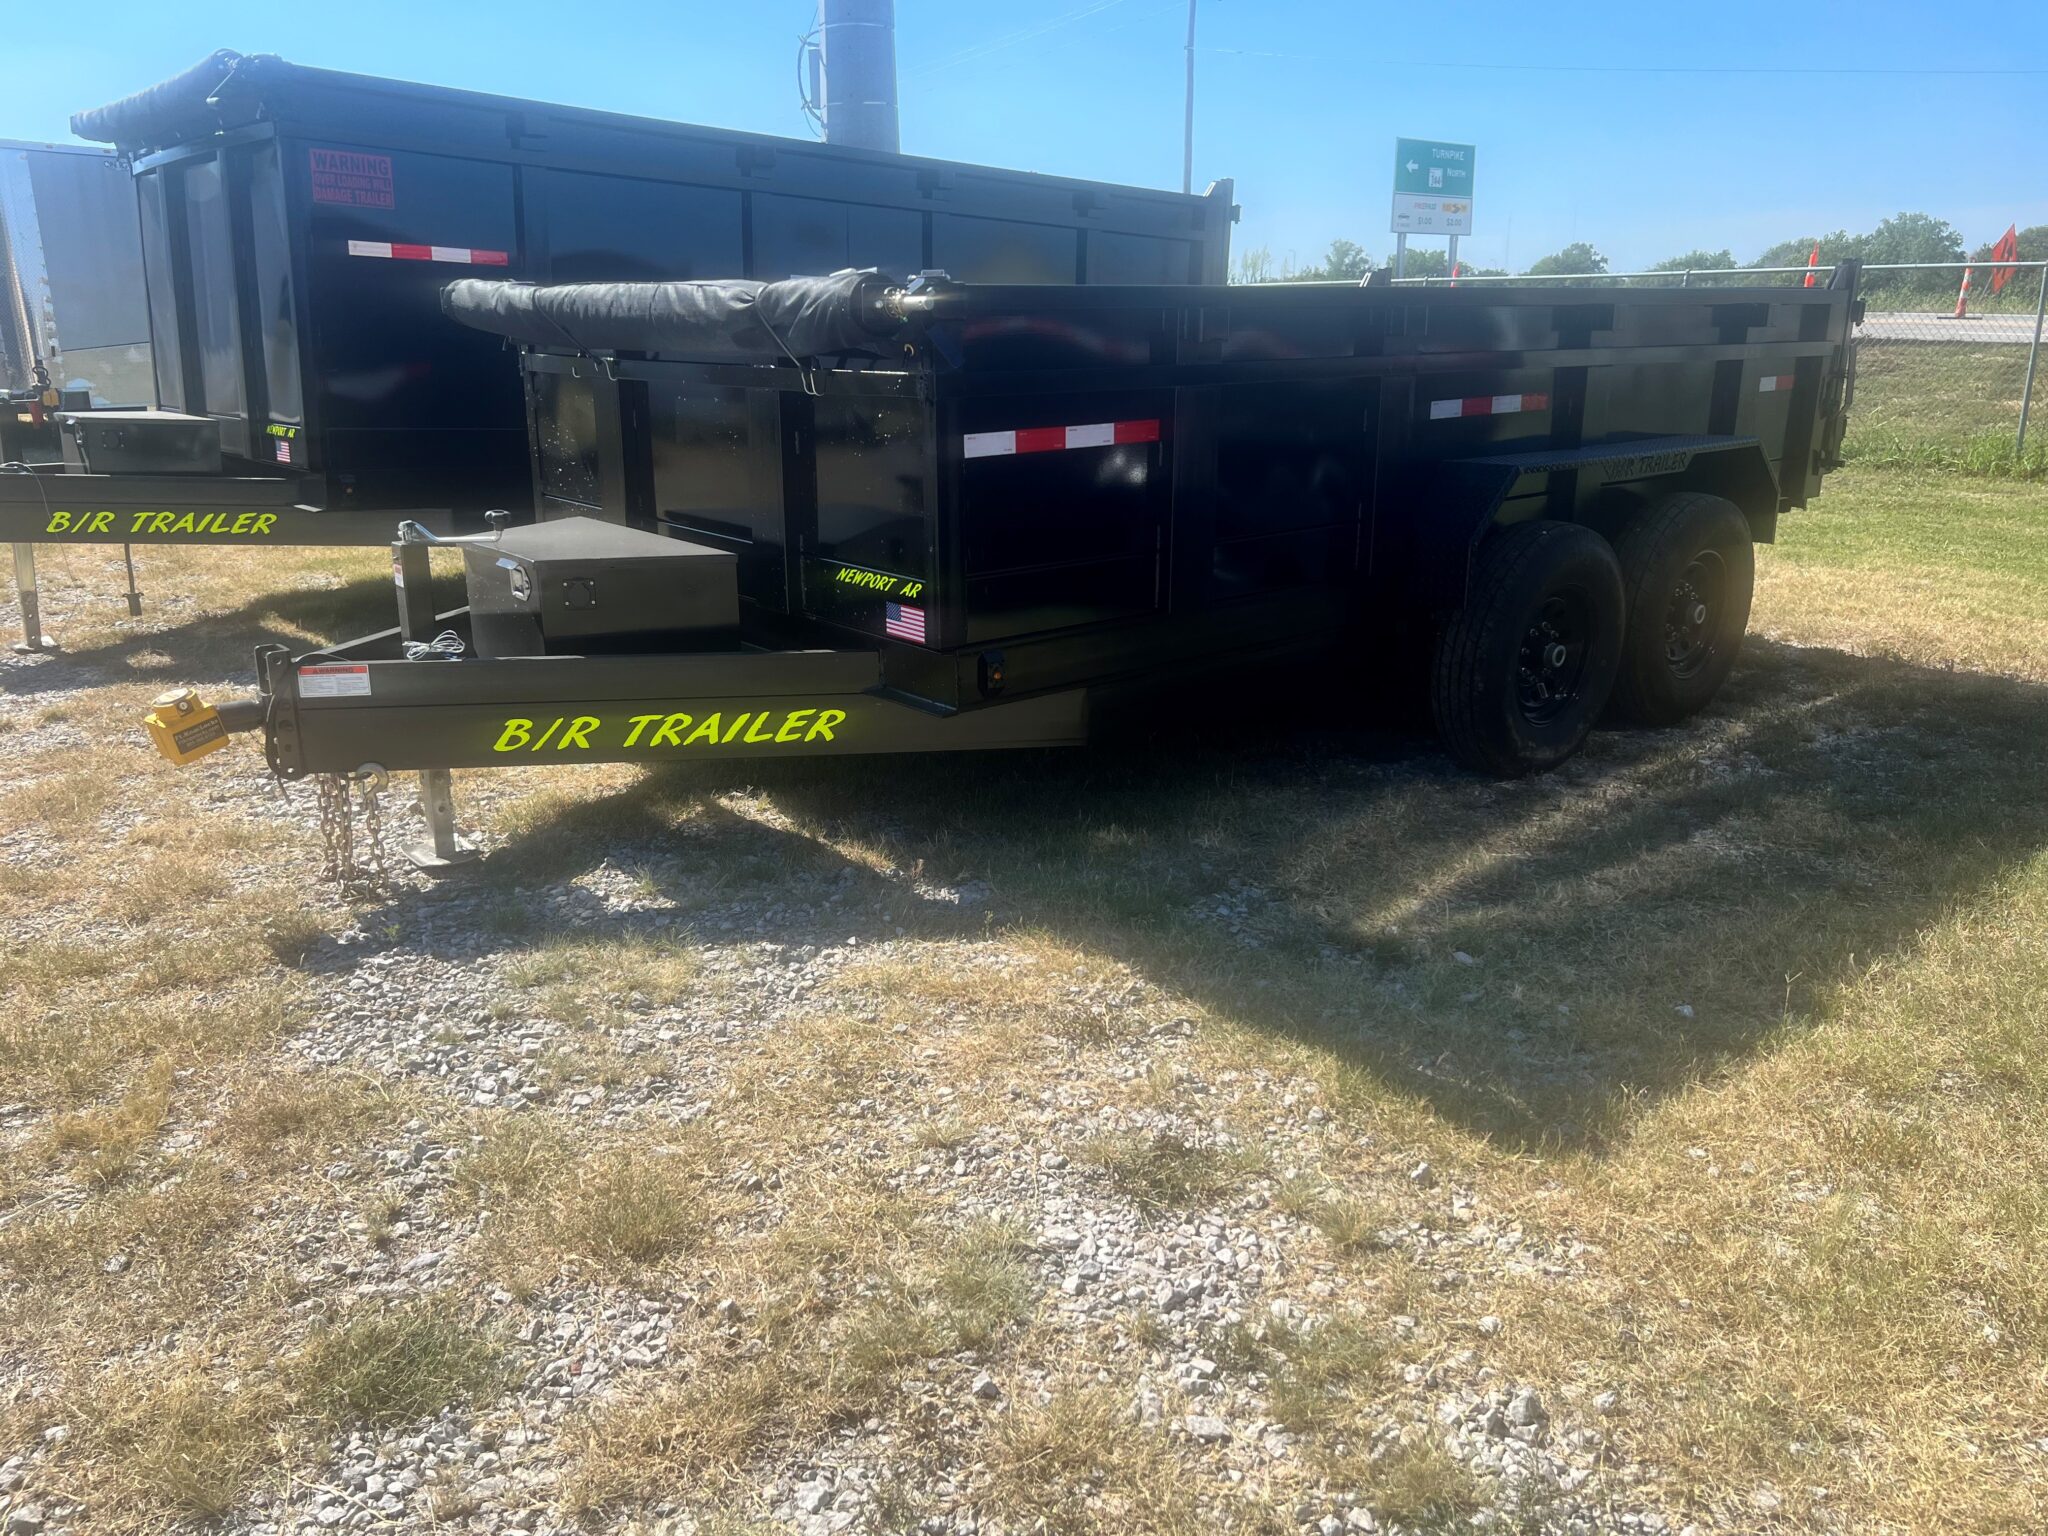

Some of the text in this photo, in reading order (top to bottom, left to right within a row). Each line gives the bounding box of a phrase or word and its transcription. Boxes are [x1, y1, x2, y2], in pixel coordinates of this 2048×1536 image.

[312, 151, 389, 176] WARNING
[1432, 148, 1464, 161] TURNPIKE
[314, 173, 336, 187] OVER
[337, 174, 371, 190] LOADING
[314, 187, 393, 207] DAMAGE TRAILER
[1639, 452, 1687, 474] TRAILER
[46, 511, 278, 534] B/R TRAILER
[836, 567, 923, 598] NEWPORT AR
[493, 708, 847, 752] B/R TRAILER
